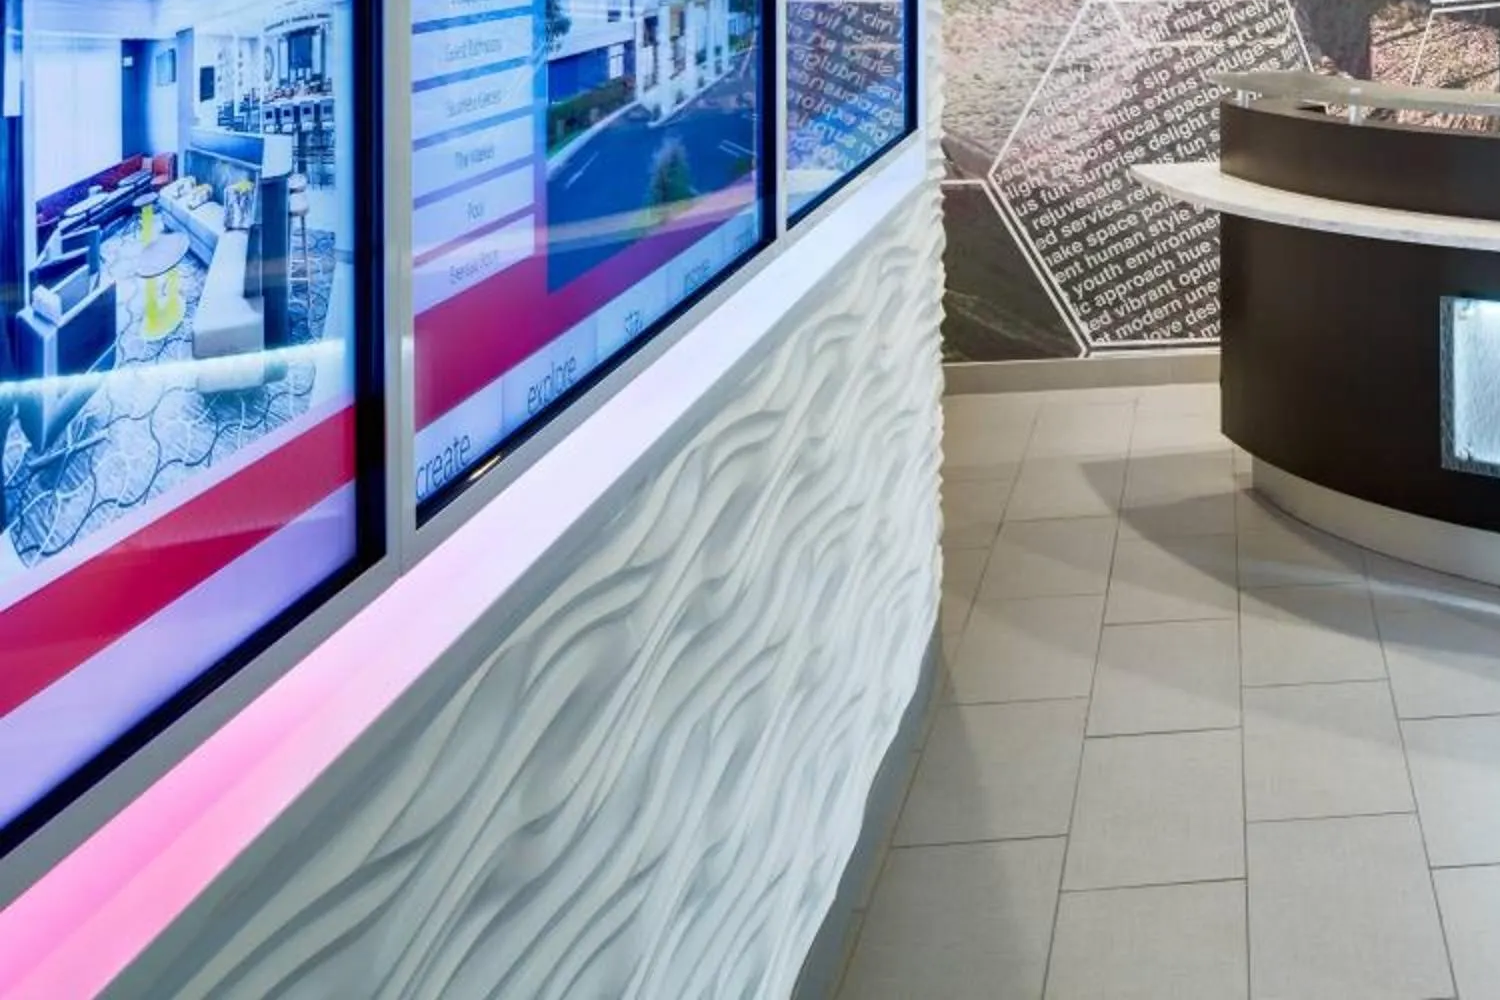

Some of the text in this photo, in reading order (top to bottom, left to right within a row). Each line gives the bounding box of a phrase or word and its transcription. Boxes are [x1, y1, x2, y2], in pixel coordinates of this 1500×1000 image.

[1173, 8, 1206, 32] mix
[1143, 69, 1171, 90] sip
[1173, 42, 1226, 74] shake
[1227, 28, 1254, 49] art
[1143, 77, 1199, 110] extras
[1006, 171, 1047, 201] light
[1117, 114, 1160, 146] local
[1072, 143, 1148, 188] surprise
[1148, 112, 1210, 152] delight
[1031, 136, 1208, 231] rejuvenate fun
[1054, 205, 1194, 285] ent human style
[1060, 198, 1124, 239] service
[1085, 213, 1140, 249] space
[1071, 259, 1124, 301] youth
[1092, 256, 1178, 310] approach
[1176, 239, 1213, 266] hue
[1113, 278, 1178, 319] vibrant
[1115, 297, 1185, 341] modern
[1184, 296, 1220, 327] desi
[527, 353, 578, 415] explore
[415, 433, 471, 501] create
